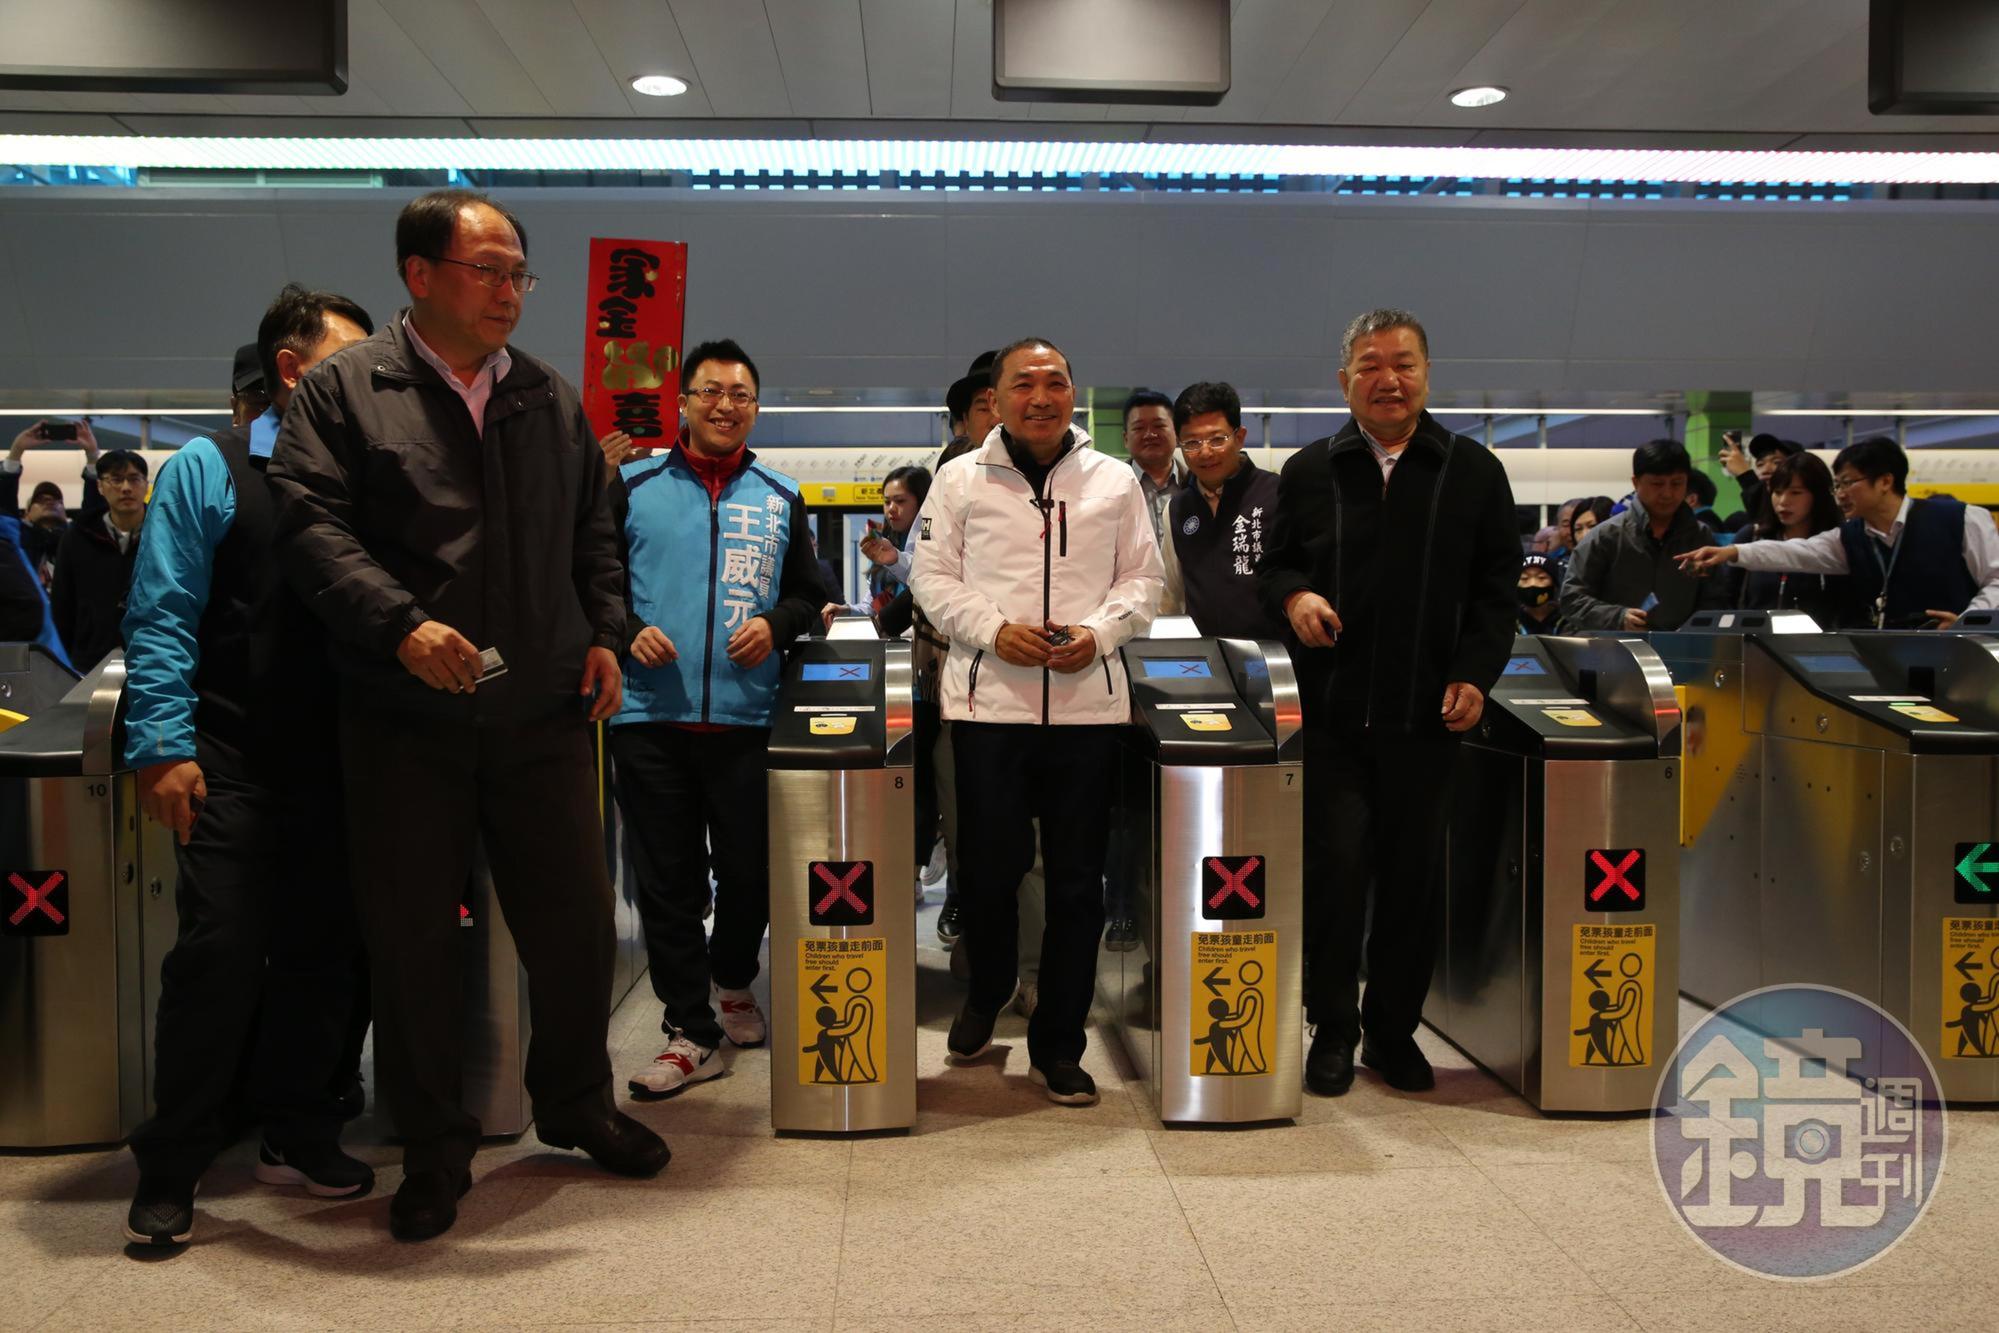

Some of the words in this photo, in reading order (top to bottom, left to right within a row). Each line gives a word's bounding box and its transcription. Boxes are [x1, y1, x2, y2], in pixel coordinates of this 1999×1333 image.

[1231, 514, 1253, 575] 金瑞龍
[721, 503, 764, 629] 王威元
[1664, 766, 1673, 779] 6
[894, 776, 904, 789] 8
[1285, 773, 1294, 786] 7
[87, 783, 107, 797] 10
[1580, 926, 1653, 938] 免票孩童走前面
[805, 939, 883, 952] 免票孩童走前面
[1198, 932, 1274, 946] 免票孩童走前面
